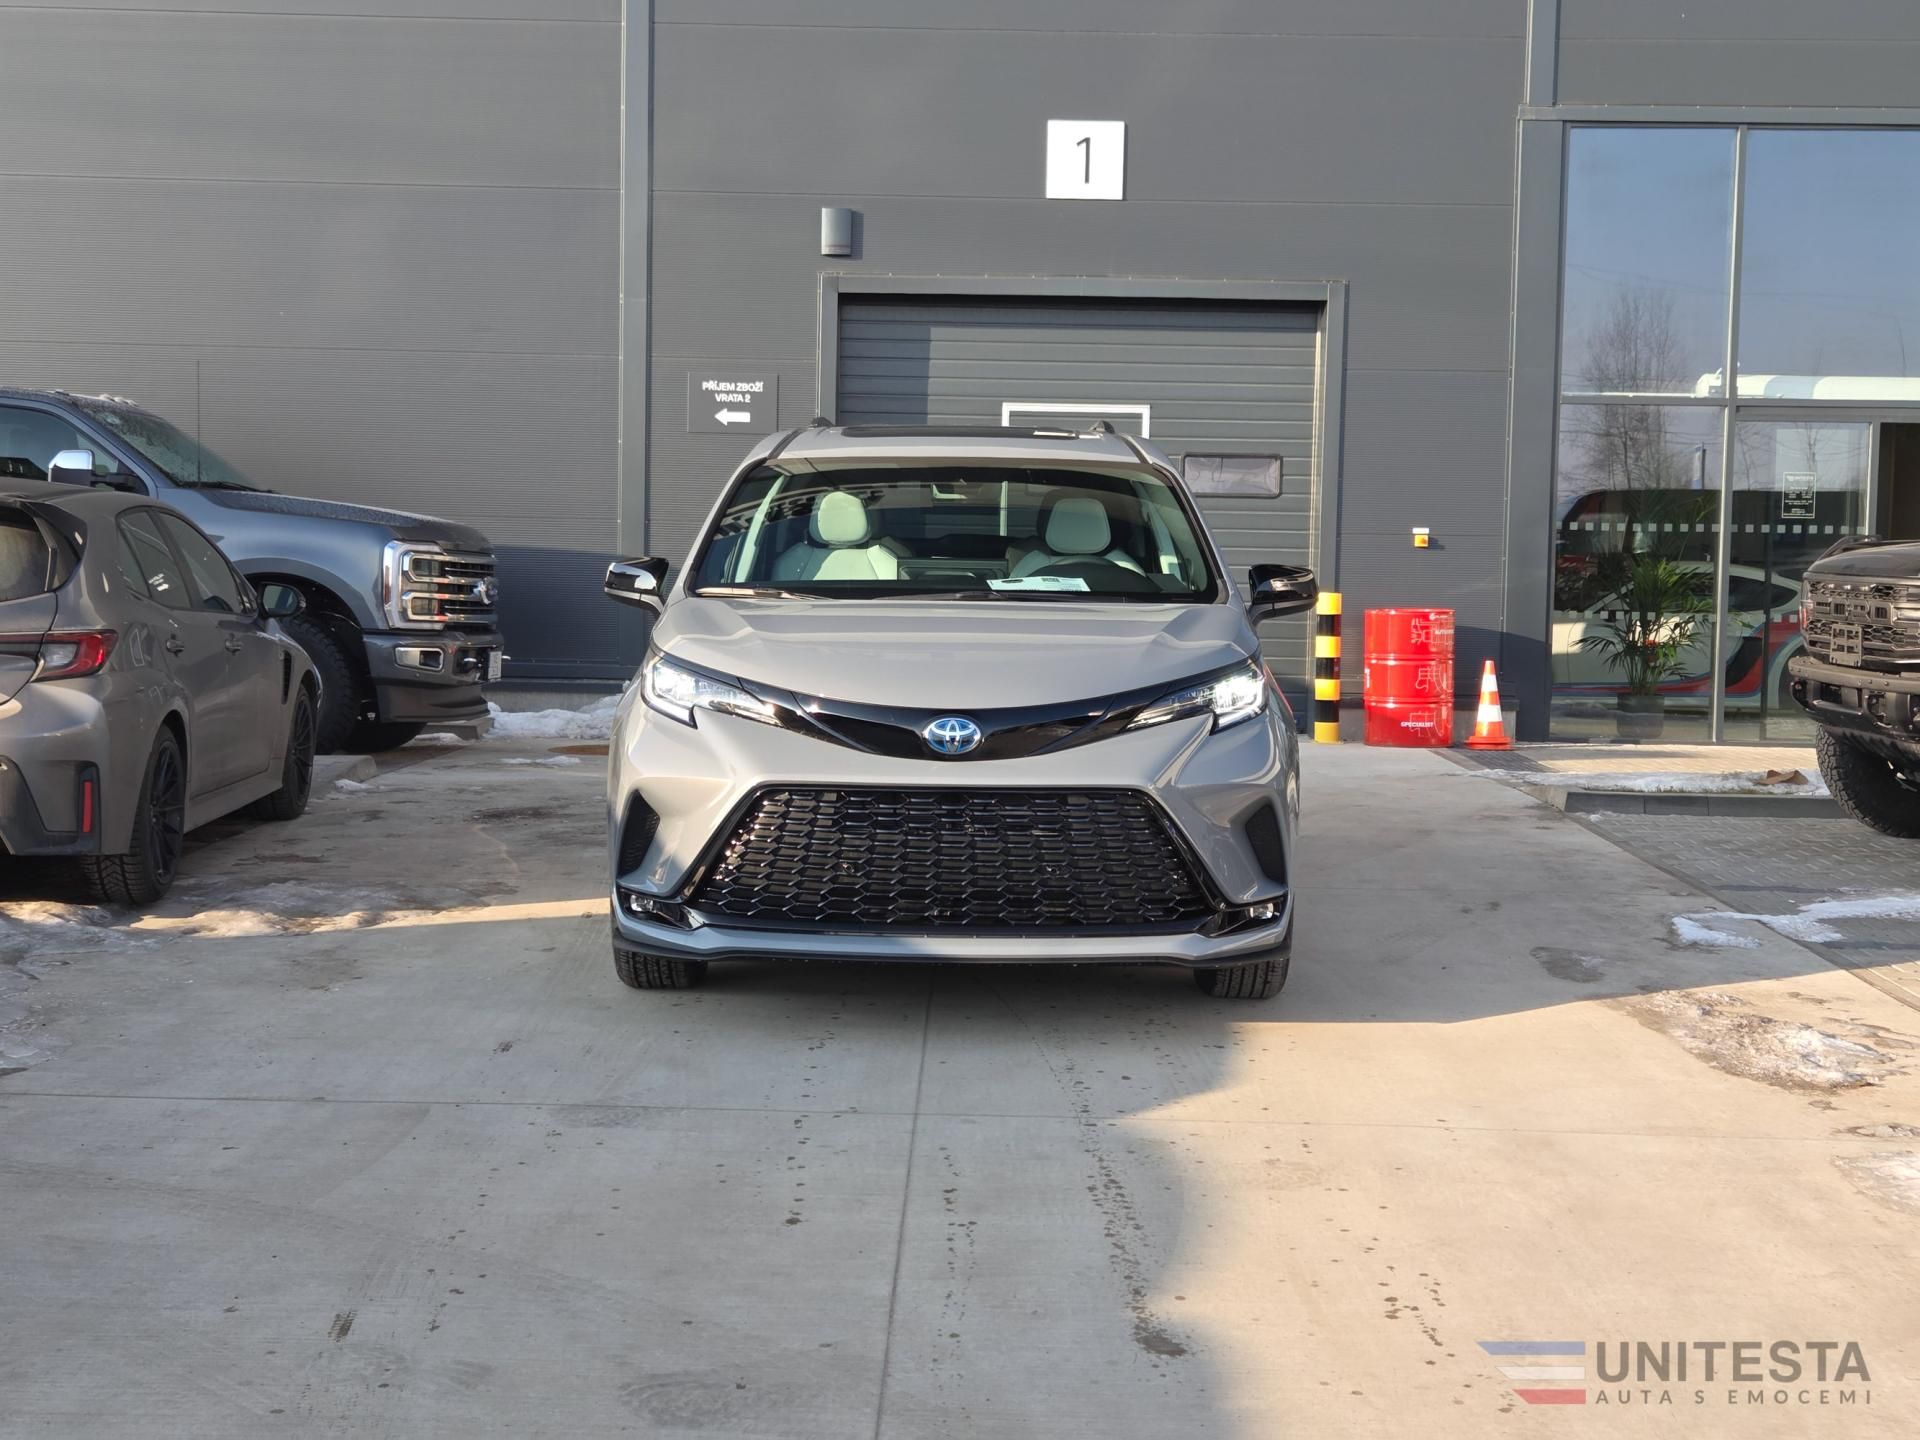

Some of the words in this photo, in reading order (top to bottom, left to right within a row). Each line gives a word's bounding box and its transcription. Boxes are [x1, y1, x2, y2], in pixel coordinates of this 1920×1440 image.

[1076, 136, 1091, 184] 1
[702, 380, 735, 391] PŘÍJEM
[736, 381, 764, 392] ZBOŽÍ
[715, 393, 744, 402] VRATA
[745, 394, 751, 403] 2
